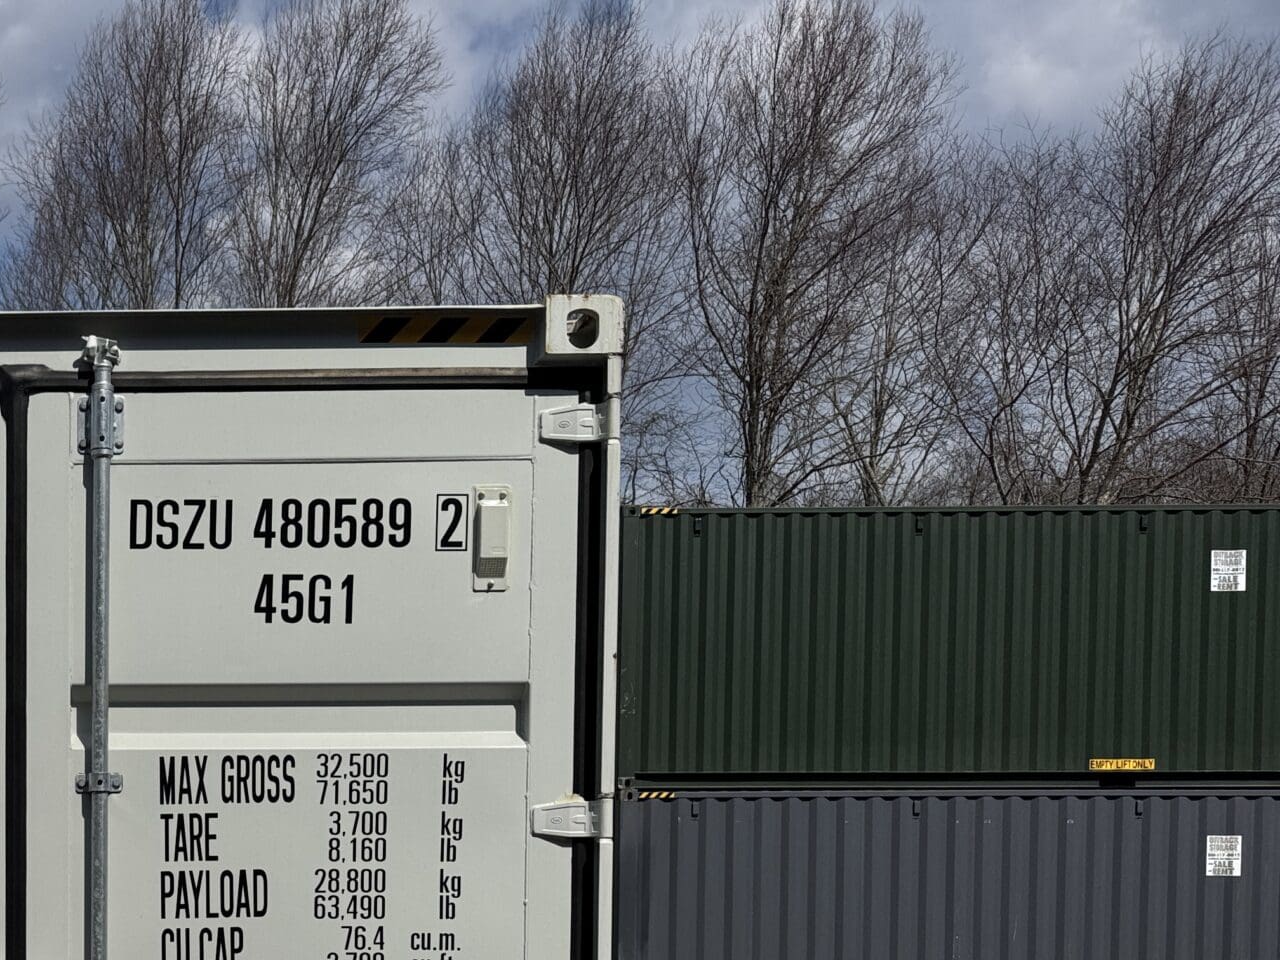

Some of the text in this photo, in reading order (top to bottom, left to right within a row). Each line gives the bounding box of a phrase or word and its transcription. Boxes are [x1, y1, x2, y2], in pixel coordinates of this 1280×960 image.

[129, 498, 464, 549] DSZU 480589 2
[254, 574, 354, 624] 45G1
[159, 753, 465, 805] MAX GROSS 32,500 kg
[1090, 760, 1113, 768] EMPTY
[1132, 760, 1154, 768] ONLY
[317, 780, 459, 806] 71,650 lb
[160, 811, 463, 862] TARE 3,700 kg
[328, 838, 457, 863] 8,160 lb
[160, 868, 462, 919] PAYLOAD 28,800 kg
[313, 895, 456, 920] 63,490 lb
[341, 926, 385, 951] 76.4
[410, 932, 461, 951] cu.m.
